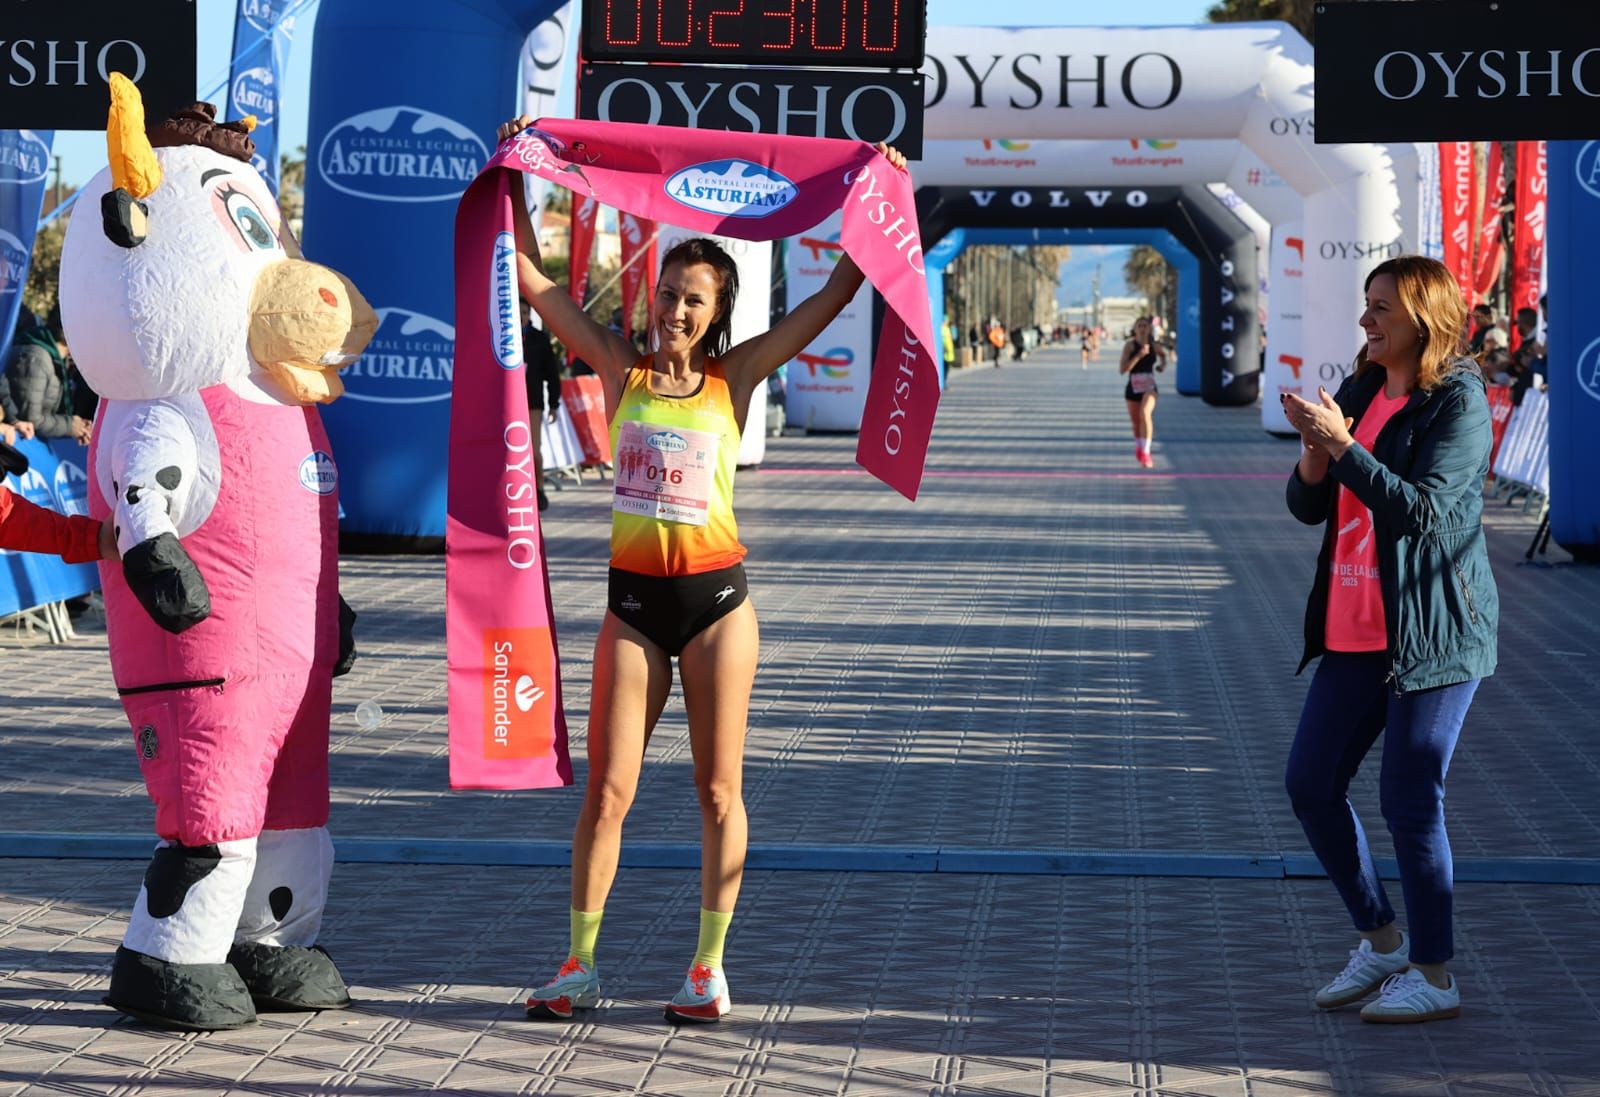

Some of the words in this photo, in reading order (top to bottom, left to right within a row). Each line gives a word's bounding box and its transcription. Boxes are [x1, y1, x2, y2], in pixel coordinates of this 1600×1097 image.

[0, 40, 147, 87] SHO
[350, 138, 411, 149] CENTRAL
[417, 140, 476, 153] LECHERA
[965, 157, 1036, 168] TotalEnergies
[1112, 156, 1184, 167] TotalEnergies
[675, 177, 787, 207] ASTURIANA
[697, 177, 741, 188] CENTRAL
[744, 180, 788, 191] LECHERA
[970, 190, 1148, 207] VOLVO
[1320, 241, 1403, 260] OYSHO
[496, 245, 514, 359] ASTURIANA
[1221, 260, 1234, 388] VOLVO
[406, 341, 454, 353] LECHE
[795, 383, 854, 394] TotalEnergies
[646, 465, 683, 485] 016
[503, 421, 536, 570] OYSHO
[494, 641, 511, 746] Santander
